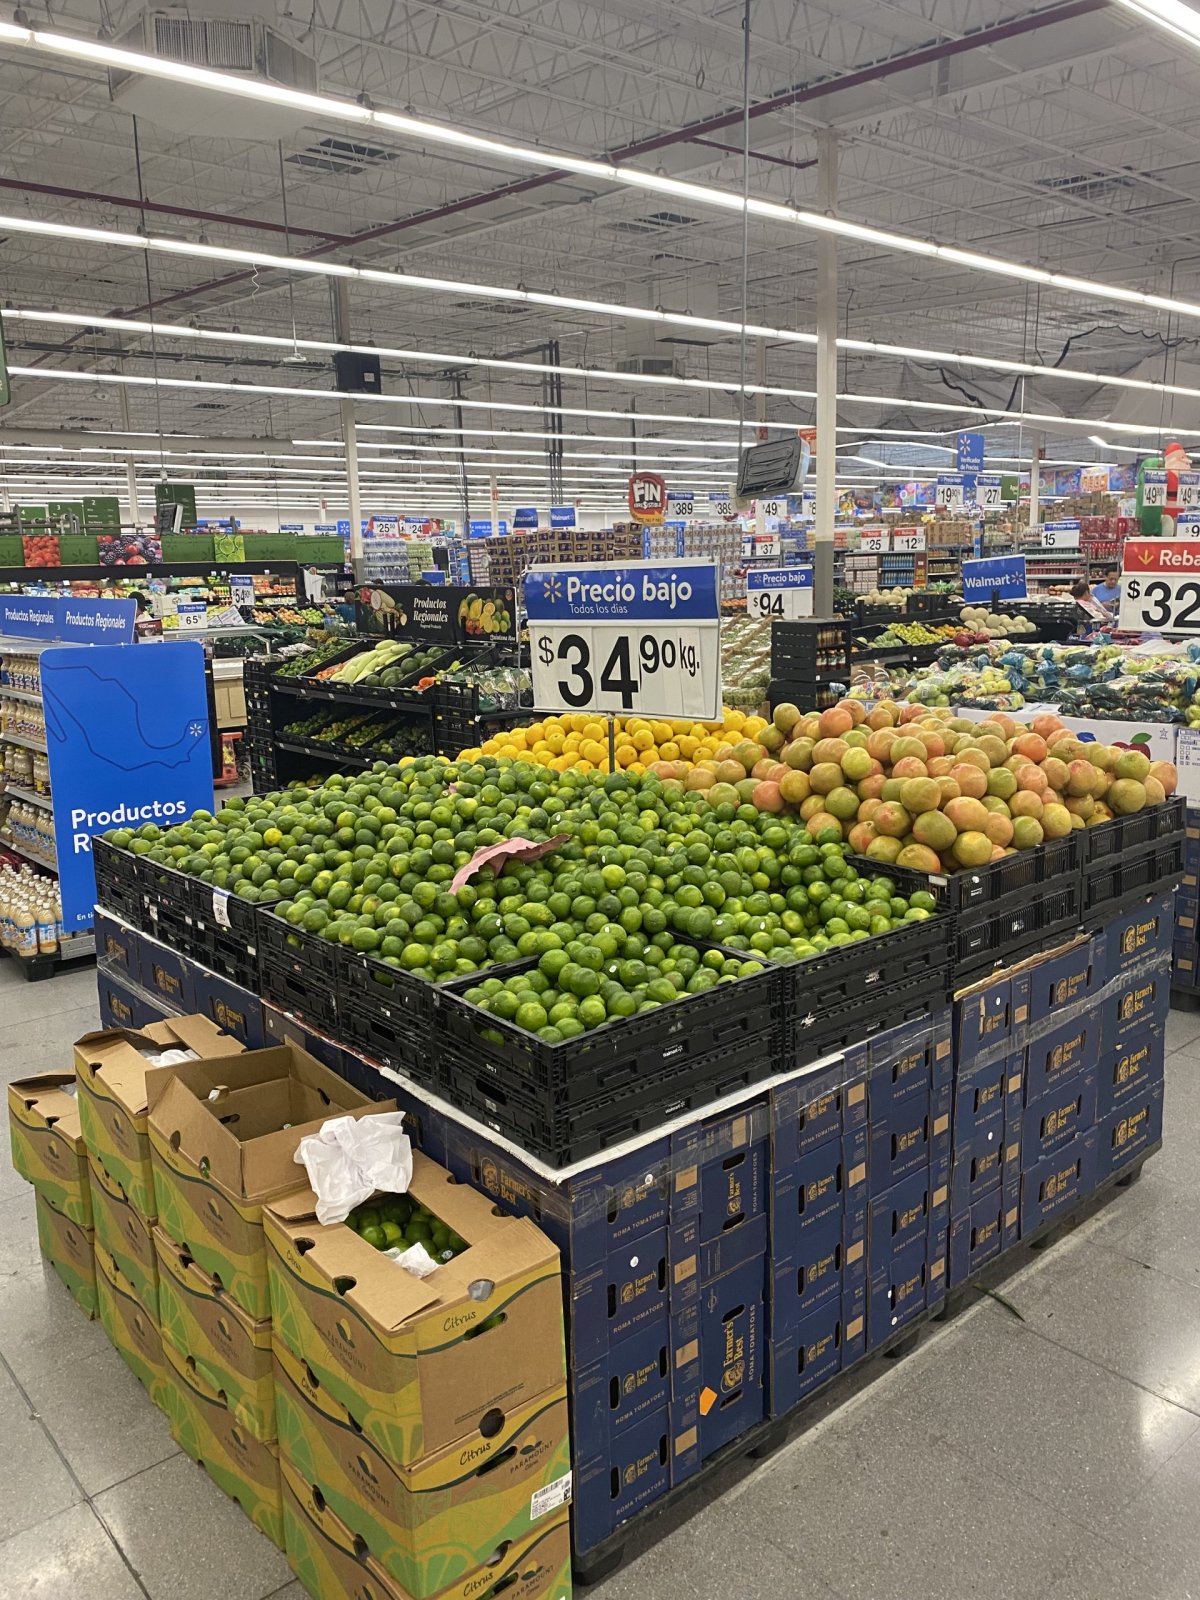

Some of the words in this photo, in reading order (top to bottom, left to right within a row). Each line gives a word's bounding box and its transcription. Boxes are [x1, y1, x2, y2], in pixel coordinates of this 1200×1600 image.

[632, 482, 662, 502] FIN
[1044, 533, 1056, 546] 15
[762, 574, 788, 584] Precio
[788, 572, 806, 584] bajo
[964, 574, 1011, 588] Walmart
[567, 576, 636, 602] Precio
[642, 574, 692, 610] bajo
[414, 598, 448, 609] Productos
[570, 603, 594, 614] Todos
[596, 603, 610, 614] los
[5, 608, 28, 622] Productos
[29, 610, 54, 625] Regionales
[66, 611, 94, 627] Productos
[95, 612, 126, 632] Regionales
[414, 610, 449, 624] Regionales
[71, 799, 187, 830] Productos
[1136, 918, 1156, 936] Farmer's
[1068, 970, 1088, 986] Farmer's
[1134, 983, 1152, 1000] Farmer's
[1064, 1035, 1082, 1052] Farmer's
[800, 1136, 815, 1147] ROMA
[500, 1169, 532, 1200] Farmer's
[818, 1174, 834, 1188] Farmer's
[500, 1185, 516, 1206] Best
[612, 1225, 632, 1239] ROMA
[632, 1209, 665, 1231] TOMATOES
[636, 1269, 656, 1288] Farmer's
[635, 1284, 647, 1297] Best
[443, 1310, 476, 1332] Citrus
[613, 1318, 632, 1334] ROMA
[632, 1301, 664, 1324] TOMATOES
[724, 1321, 734, 1368] Farmer's
[734, 1336, 744, 1362] Best
[636, 1360, 658, 1380] Farmer's
[301, 1376, 318, 1401] Citrus
[616, 1411, 634, 1426] ROMA
[634, 1390, 665, 1414] TOMATOES
[460, 1442, 492, 1466] Citrus
[510, 1440, 554, 1474] PARAMOUNT
[636, 1449, 658, 1468] Farmer's
[348, 1460, 390, 1508] PARAMOUNT
[616, 1500, 634, 1516] ROMA
[634, 1478, 666, 1504] TOMATOES
[463, 1572, 494, 1597] Citrus
[511, 1565, 554, 1599] PARAMOUNT
